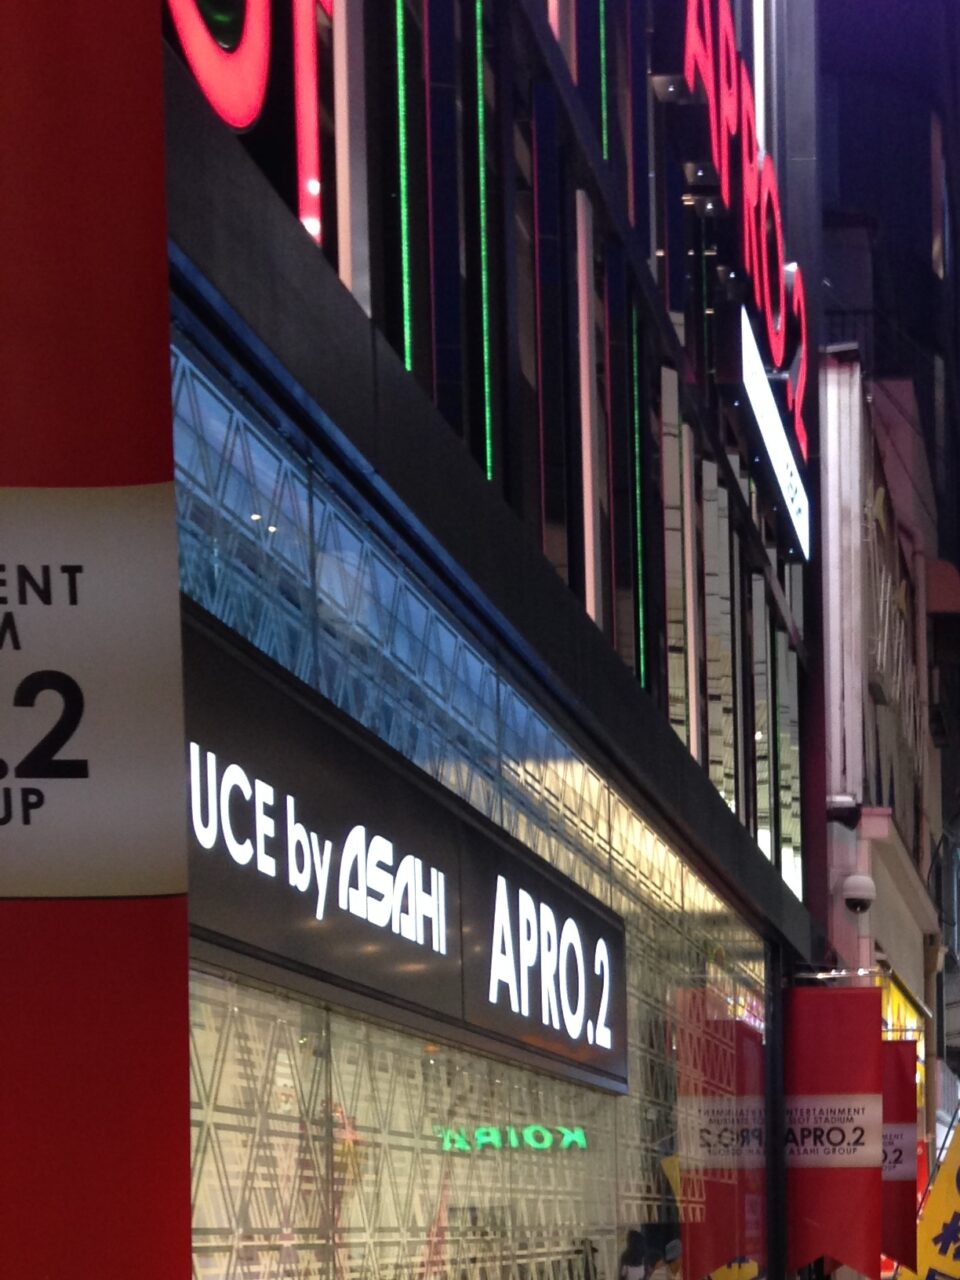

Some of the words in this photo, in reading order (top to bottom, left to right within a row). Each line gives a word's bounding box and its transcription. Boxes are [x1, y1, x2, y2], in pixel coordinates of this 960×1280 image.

[286, 794, 332, 921] by
[338, 824, 447, 955] ASAHI
[488, 874, 612, 1050] APRO.2
[786, 1107, 865, 1116] NTERTAINMENT
[784, 1127, 865, 1146] APRO.2
